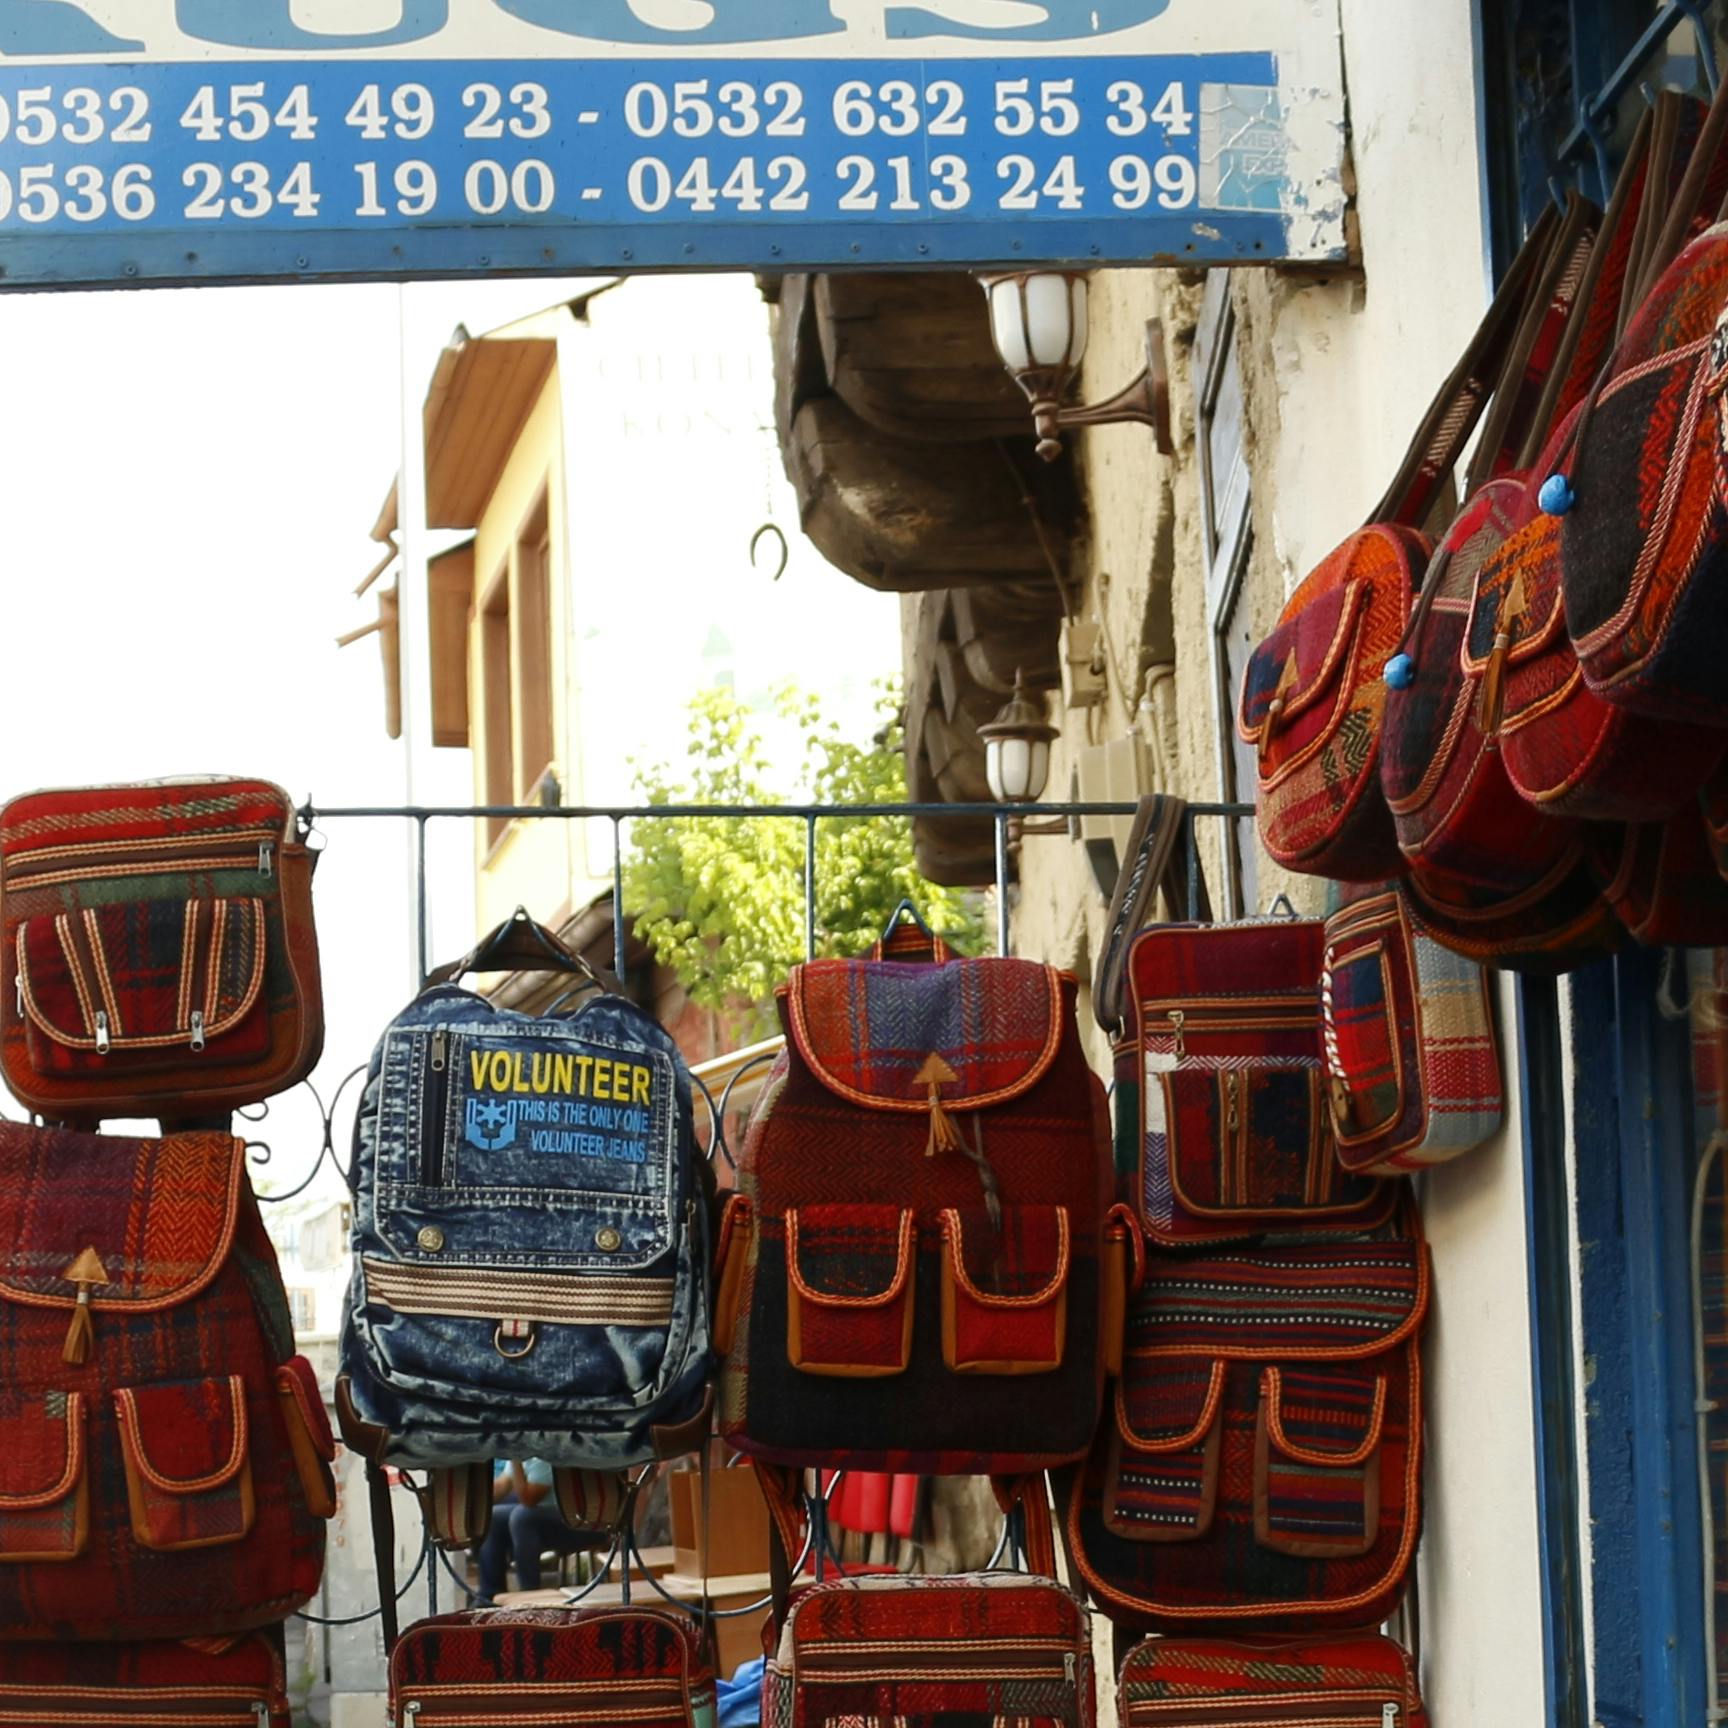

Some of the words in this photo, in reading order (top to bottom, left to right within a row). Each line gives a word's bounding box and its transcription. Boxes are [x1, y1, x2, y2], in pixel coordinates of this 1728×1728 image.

[180, 82, 318, 141] 454
[345, 83, 434, 139] 49
[462, 83, 551, 138] 23
[625, 79, 806, 137] 0532
[833, 81, 967, 136] 632
[995, 78, 1079, 136] 55
[1107, 81, 1193, 136] 34
[182, 162, 320, 218] 234
[355, 160, 437, 216] 19
[465, 160, 555, 214] 00
[628, 156, 809, 212] 0442
[836, 155, 971, 210] 213
[997, 155, 1084, 210] 24
[1109, 155, 1196, 210] 99
[470, 1050, 651, 1106] VOLUNTEER
[518, 1100, 546, 1122] THIS
[547, 1101, 560, 1123] IS
[563, 1102, 587, 1126] THE
[589, 1105, 623, 1132] ONLY
[623, 1109, 649, 1133] ONE
[531, 1129, 604, 1157] VOLUNTEER
[606, 1138, 646, 1163] JEANS
